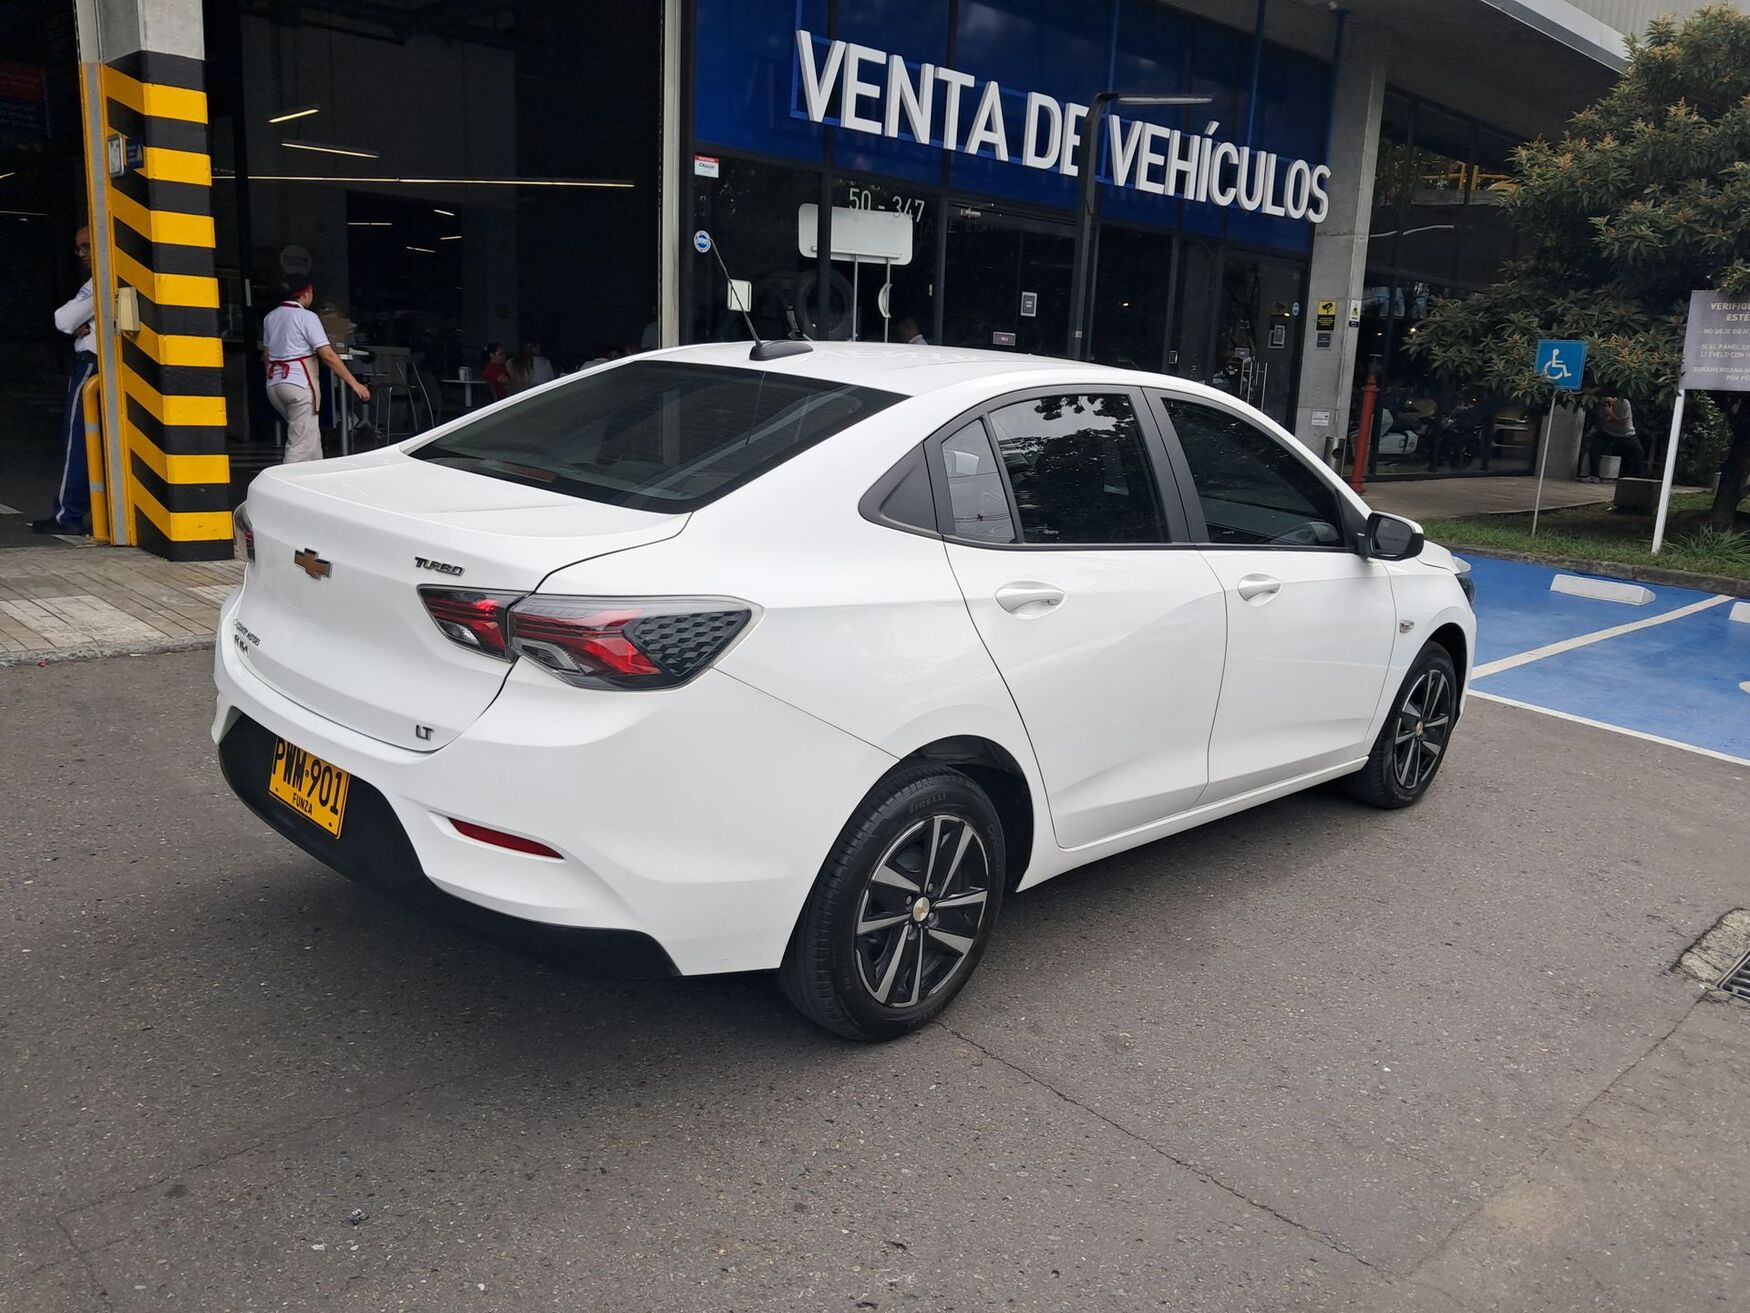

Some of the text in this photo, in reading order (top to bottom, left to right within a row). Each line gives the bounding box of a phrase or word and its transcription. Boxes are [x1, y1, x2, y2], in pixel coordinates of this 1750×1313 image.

[796, 30, 1331, 224] VENTA DE VEHÍCULOS
[849, 188, 871, 212] 50
[893, 196, 925, 222] 347
[415, 557, 465, 576] TURBO
[416, 725, 434, 742] LT
[293, 793, 313, 815] FUNZA
